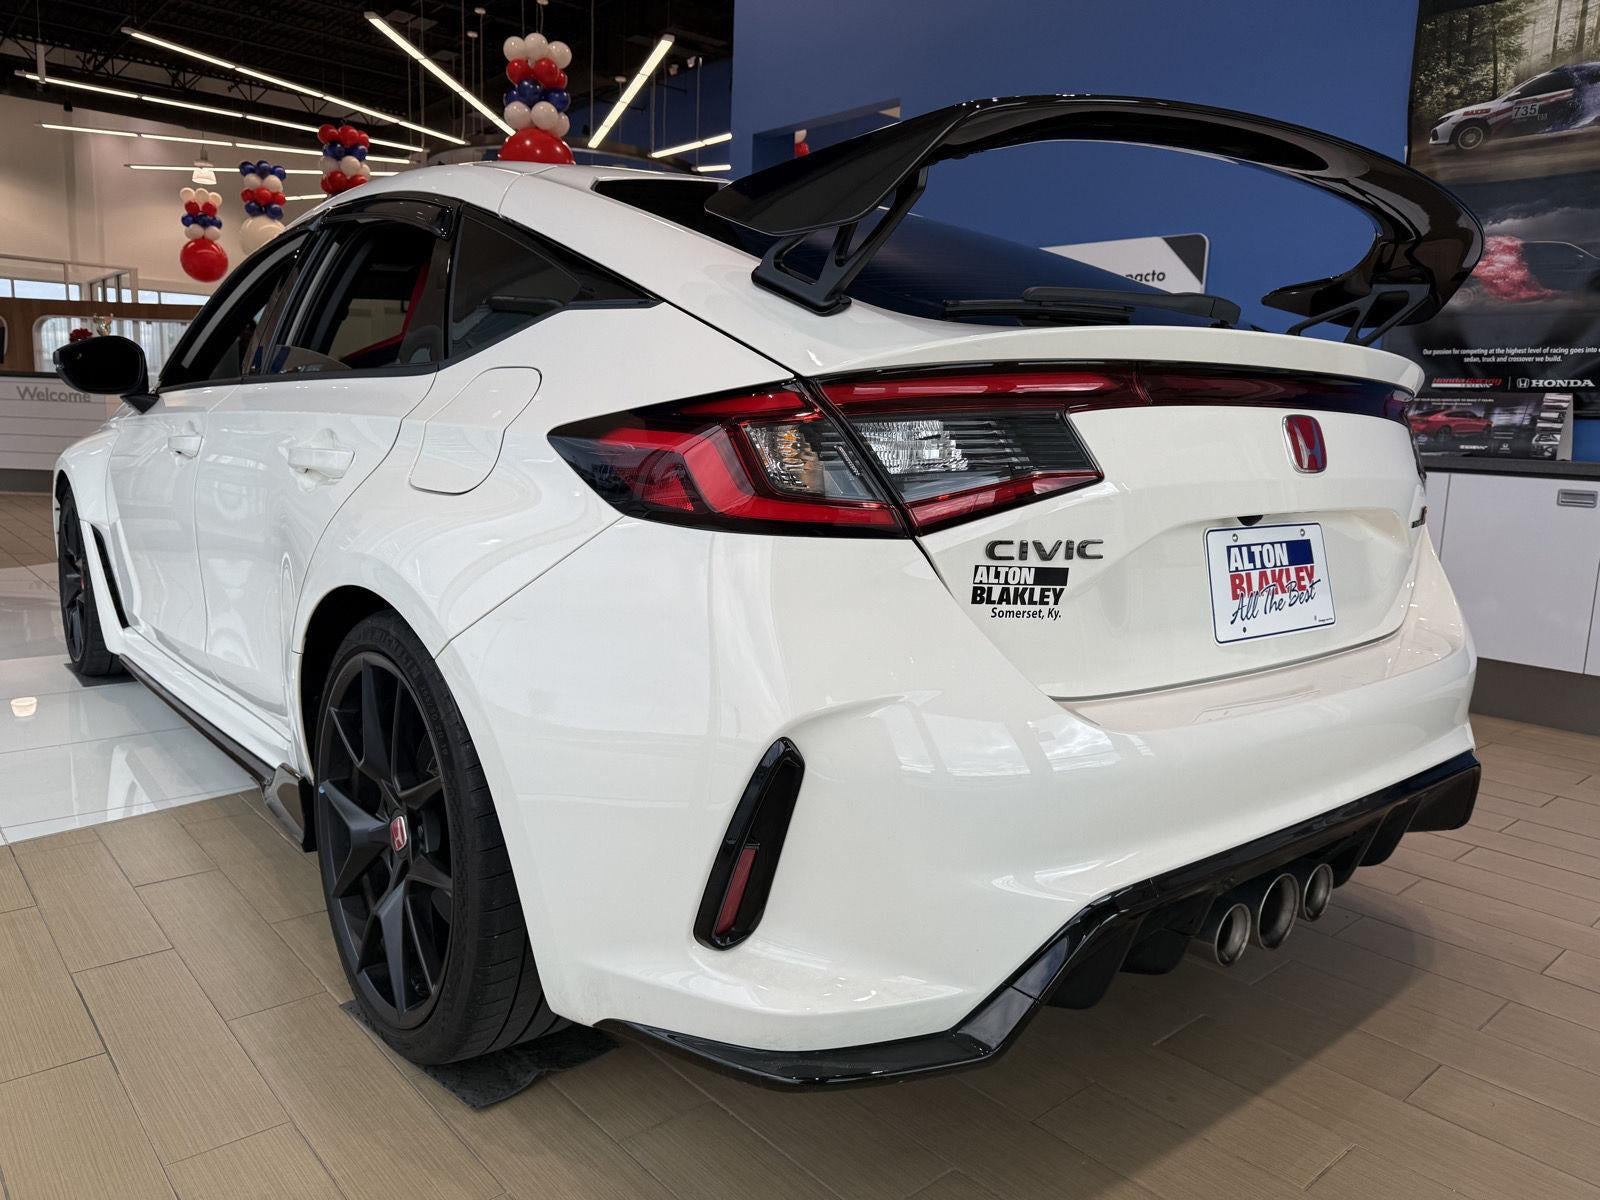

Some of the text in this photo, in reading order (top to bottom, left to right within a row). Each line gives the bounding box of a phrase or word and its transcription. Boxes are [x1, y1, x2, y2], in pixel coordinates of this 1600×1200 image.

[1513, 104, 1538, 118] 735
[1460, 347, 1488, 356] competing
[1505, 346, 1527, 355] highest
[1550, 346, 1569, 355] racing
[1569, 347, 1584, 355] goes
[1531, 379, 1595, 388] HONDA
[16, 386, 92, 403] Welcome
[985, 539, 1104, 561] CIVIC
[1229, 543, 1290, 572] ALTON
[973, 566, 1036, 585] ALTON
[1229, 565, 1315, 601] BLAKLEY
[971, 586, 1065, 606] BLAKLEY
[1230, 579, 1321, 625] All The Best
[990, 607, 1062, 621] Somerset, Ky.
